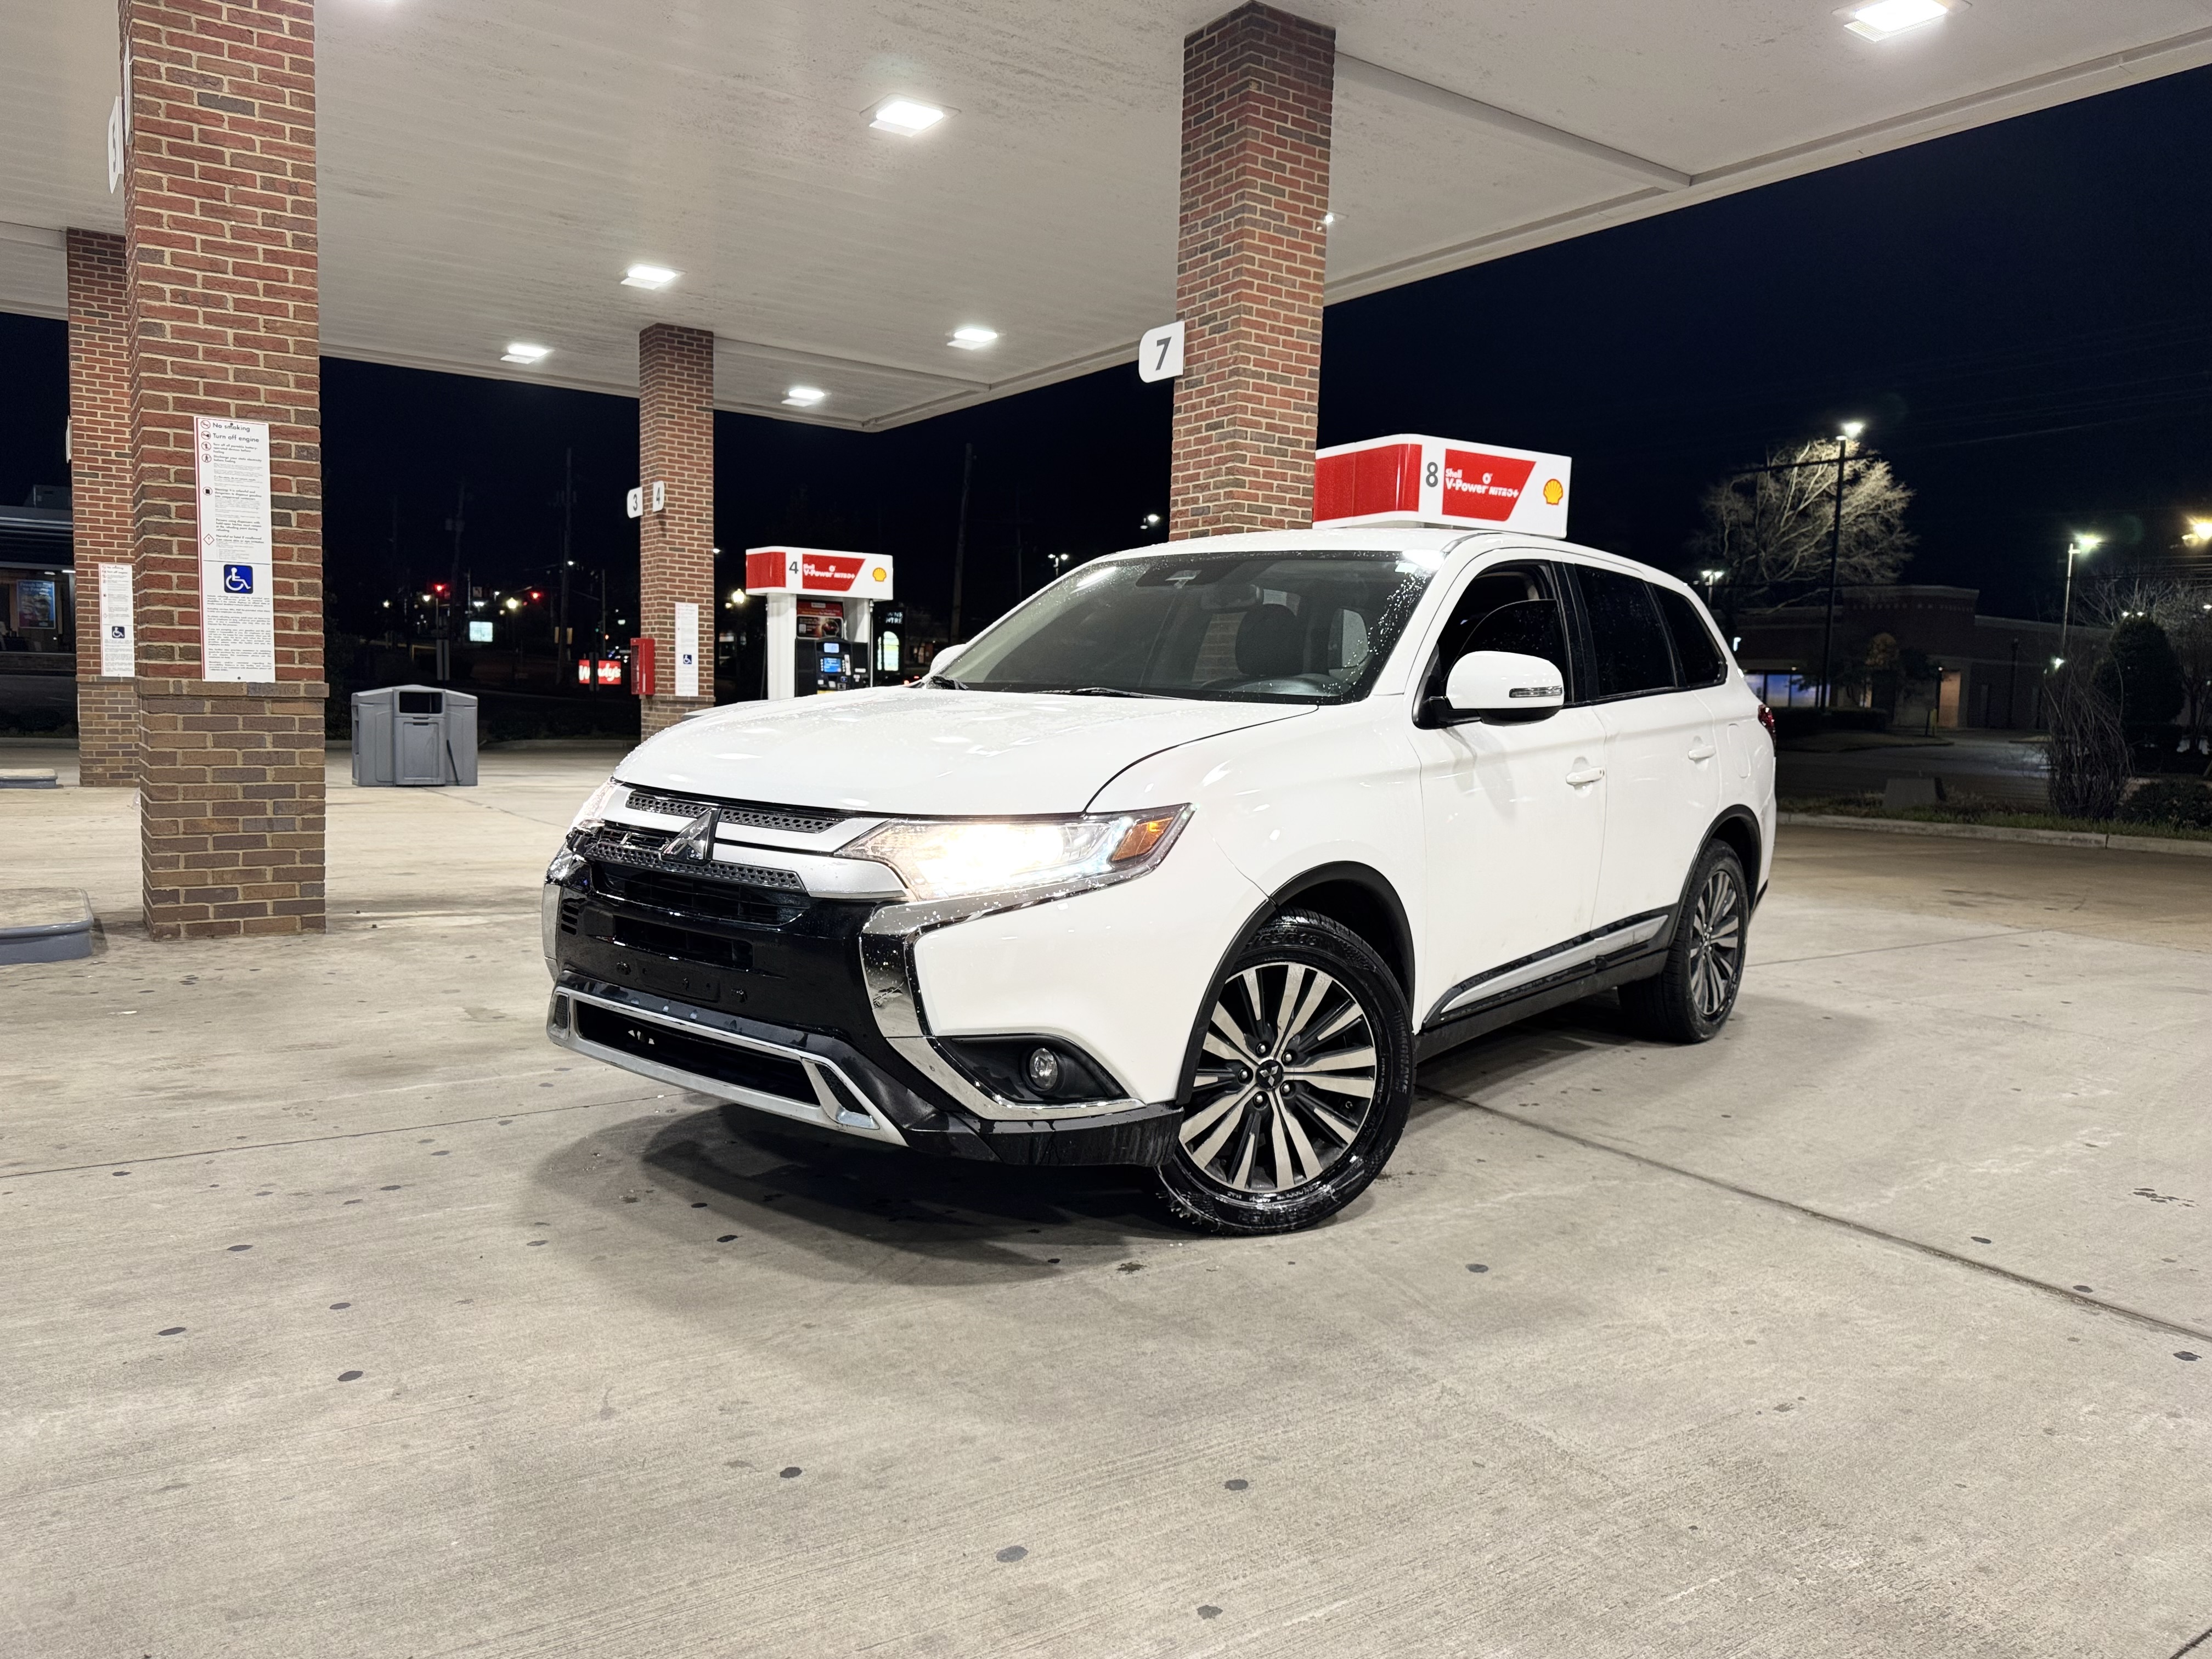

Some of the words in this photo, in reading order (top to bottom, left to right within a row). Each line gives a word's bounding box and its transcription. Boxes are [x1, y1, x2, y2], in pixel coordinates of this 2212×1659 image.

[1155, 336, 1172, 371] 7
[224, 425, 250, 433] smoking
[1426, 462, 1438, 487] 8
[1445, 468, 1463, 479] Shell
[633, 493, 638, 512] 3
[656, 487, 661, 505] 4
[789, 561, 799, 574] 4
[579, 663, 621, 682] Wndy's
